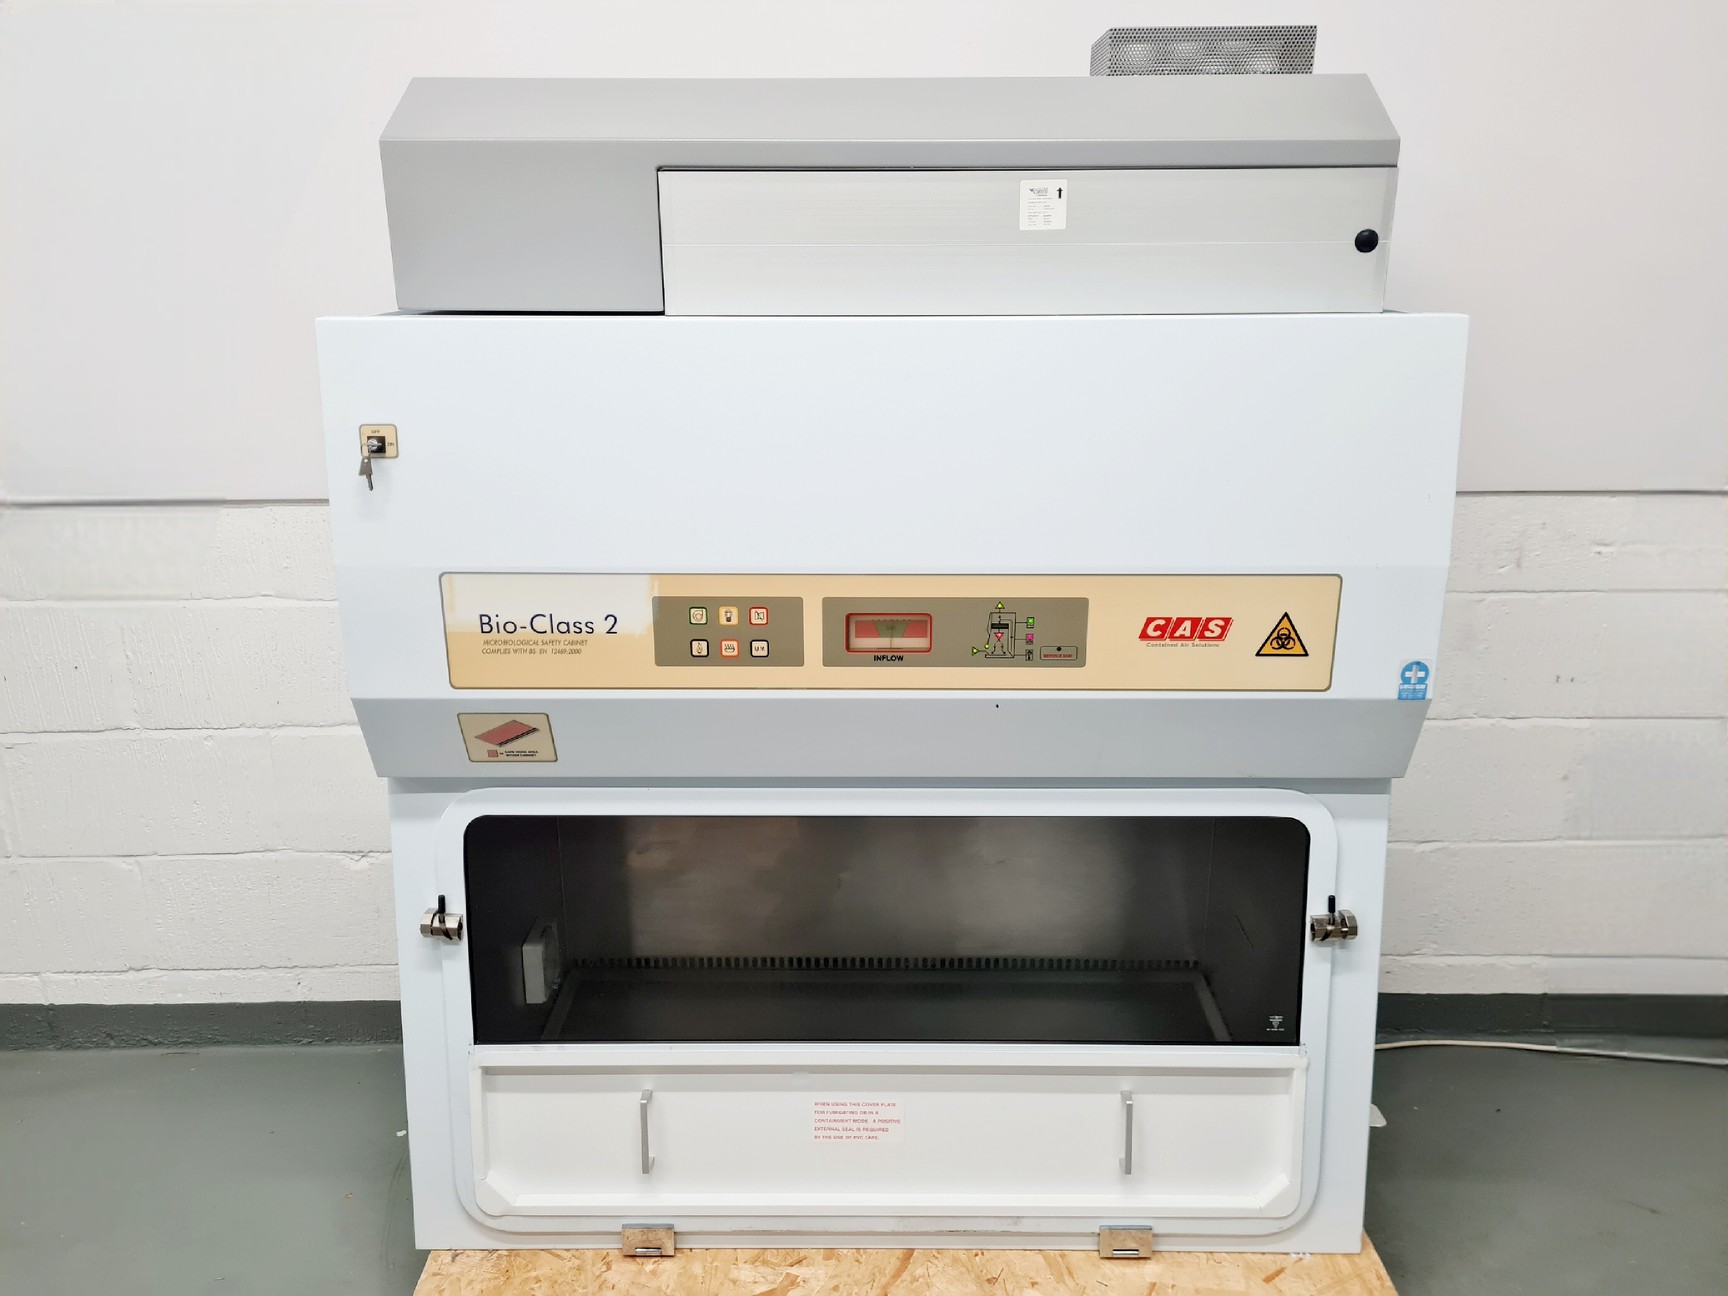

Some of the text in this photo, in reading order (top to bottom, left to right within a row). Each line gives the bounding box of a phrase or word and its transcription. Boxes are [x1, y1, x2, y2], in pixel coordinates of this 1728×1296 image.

[479, 613, 618, 634] Bio-Class 2
[1142, 618, 1229, 639] CAS
